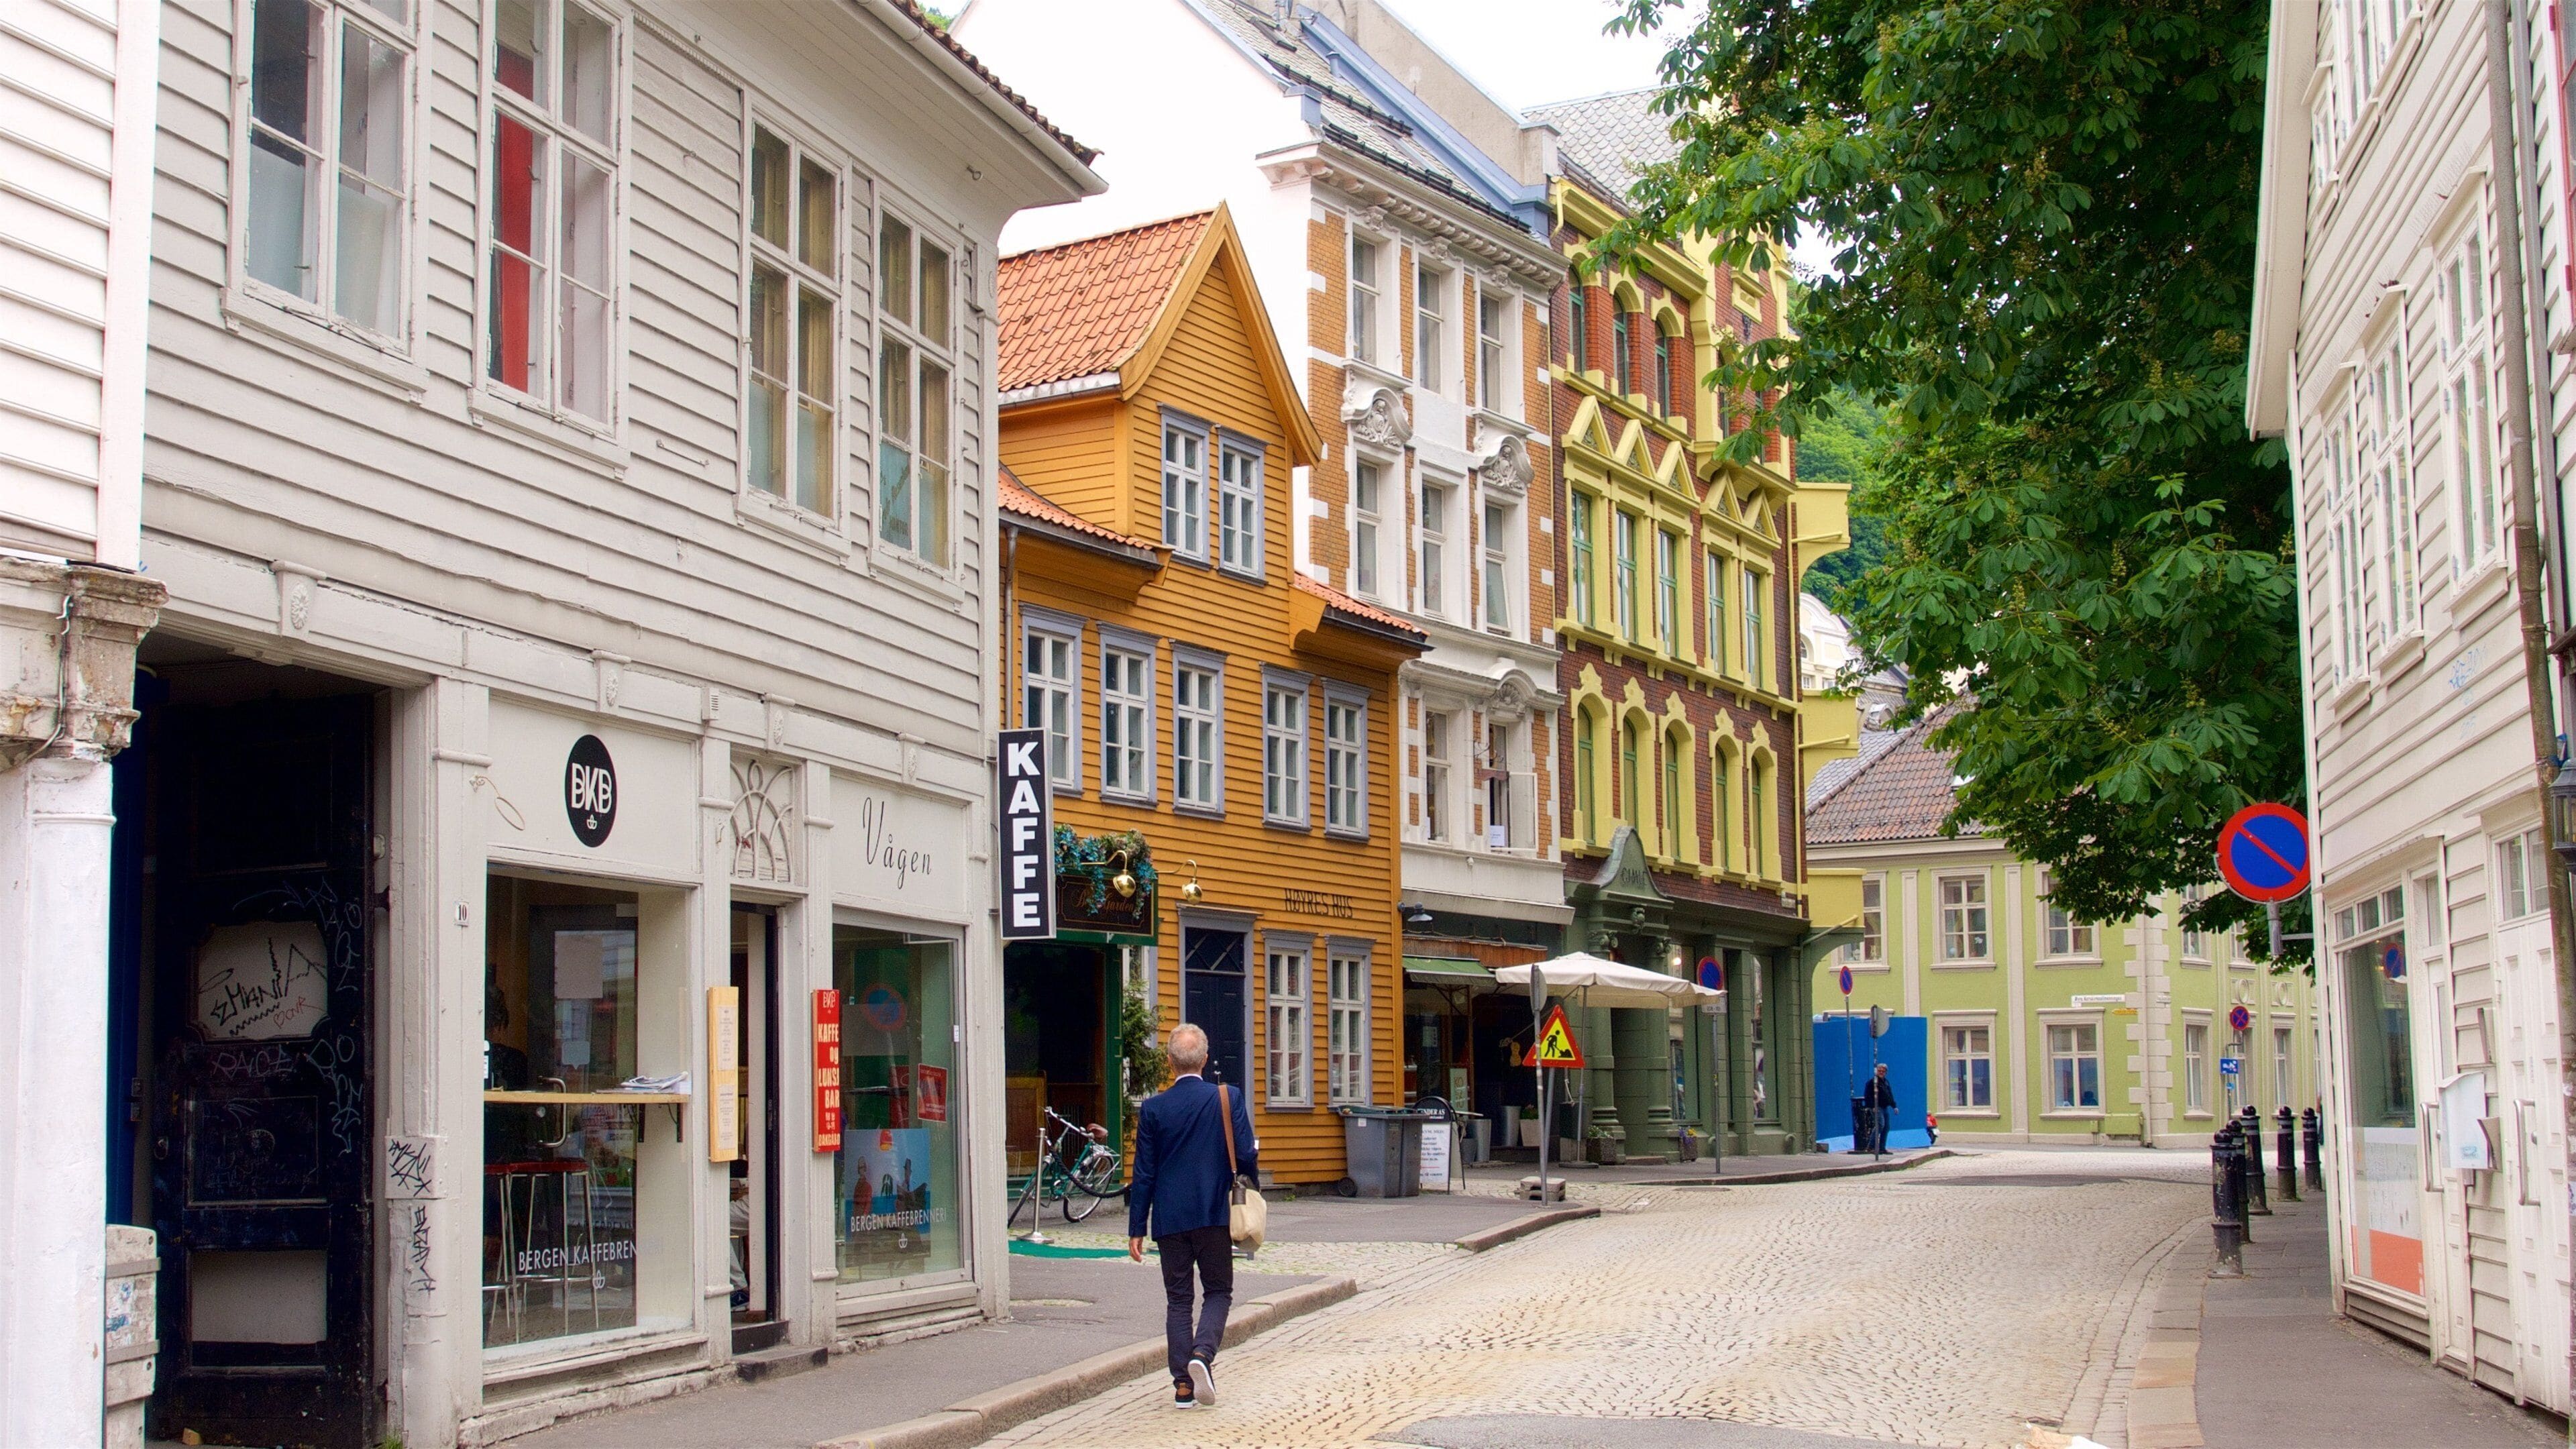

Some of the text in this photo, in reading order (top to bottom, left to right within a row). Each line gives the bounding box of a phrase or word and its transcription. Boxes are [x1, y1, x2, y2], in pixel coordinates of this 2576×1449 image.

[571, 762, 612, 814] BKB
[863, 797, 932, 890] Vågen
[1008, 741, 1041, 928] KAFFE
[458, 904, 468, 921] 10
[1285, 888, 1353, 919] HØYRES HUS
[818, 1023, 839, 1042] KAFFE
[818, 1067, 840, 1087] LUNSJ
[825, 1089, 840, 1108] BAR
[851, 1208, 947, 1232] BERGEN KAFFEBRENNERI
[519, 1247, 569, 1272] BERGEN
